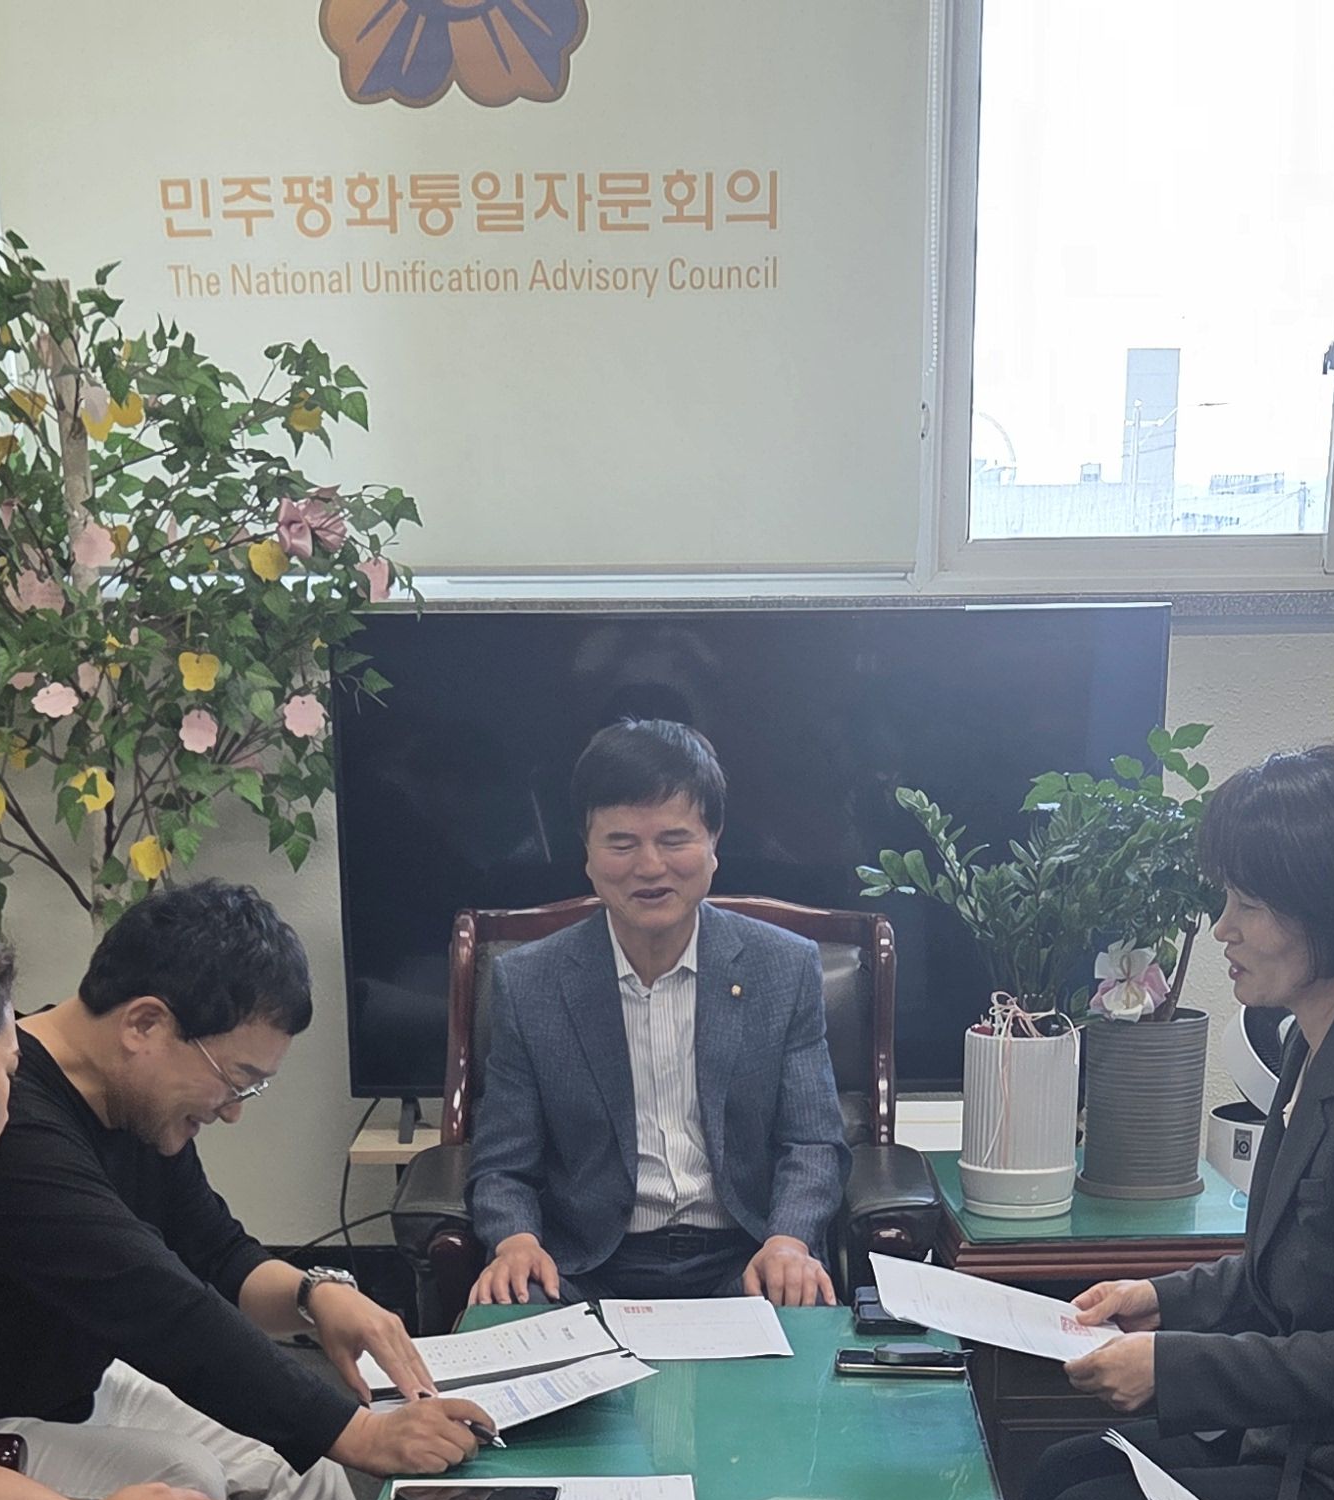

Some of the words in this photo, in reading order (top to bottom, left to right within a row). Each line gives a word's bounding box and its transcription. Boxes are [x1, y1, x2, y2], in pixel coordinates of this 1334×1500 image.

[160, 169, 779, 239] 민주평화통일자문회의
[167, 264, 221, 296] The
[231, 261, 352, 296] National
[362, 258, 519, 294] Unification
[529, 257, 659, 298] Advisory
[669, 256, 779, 291] Council
